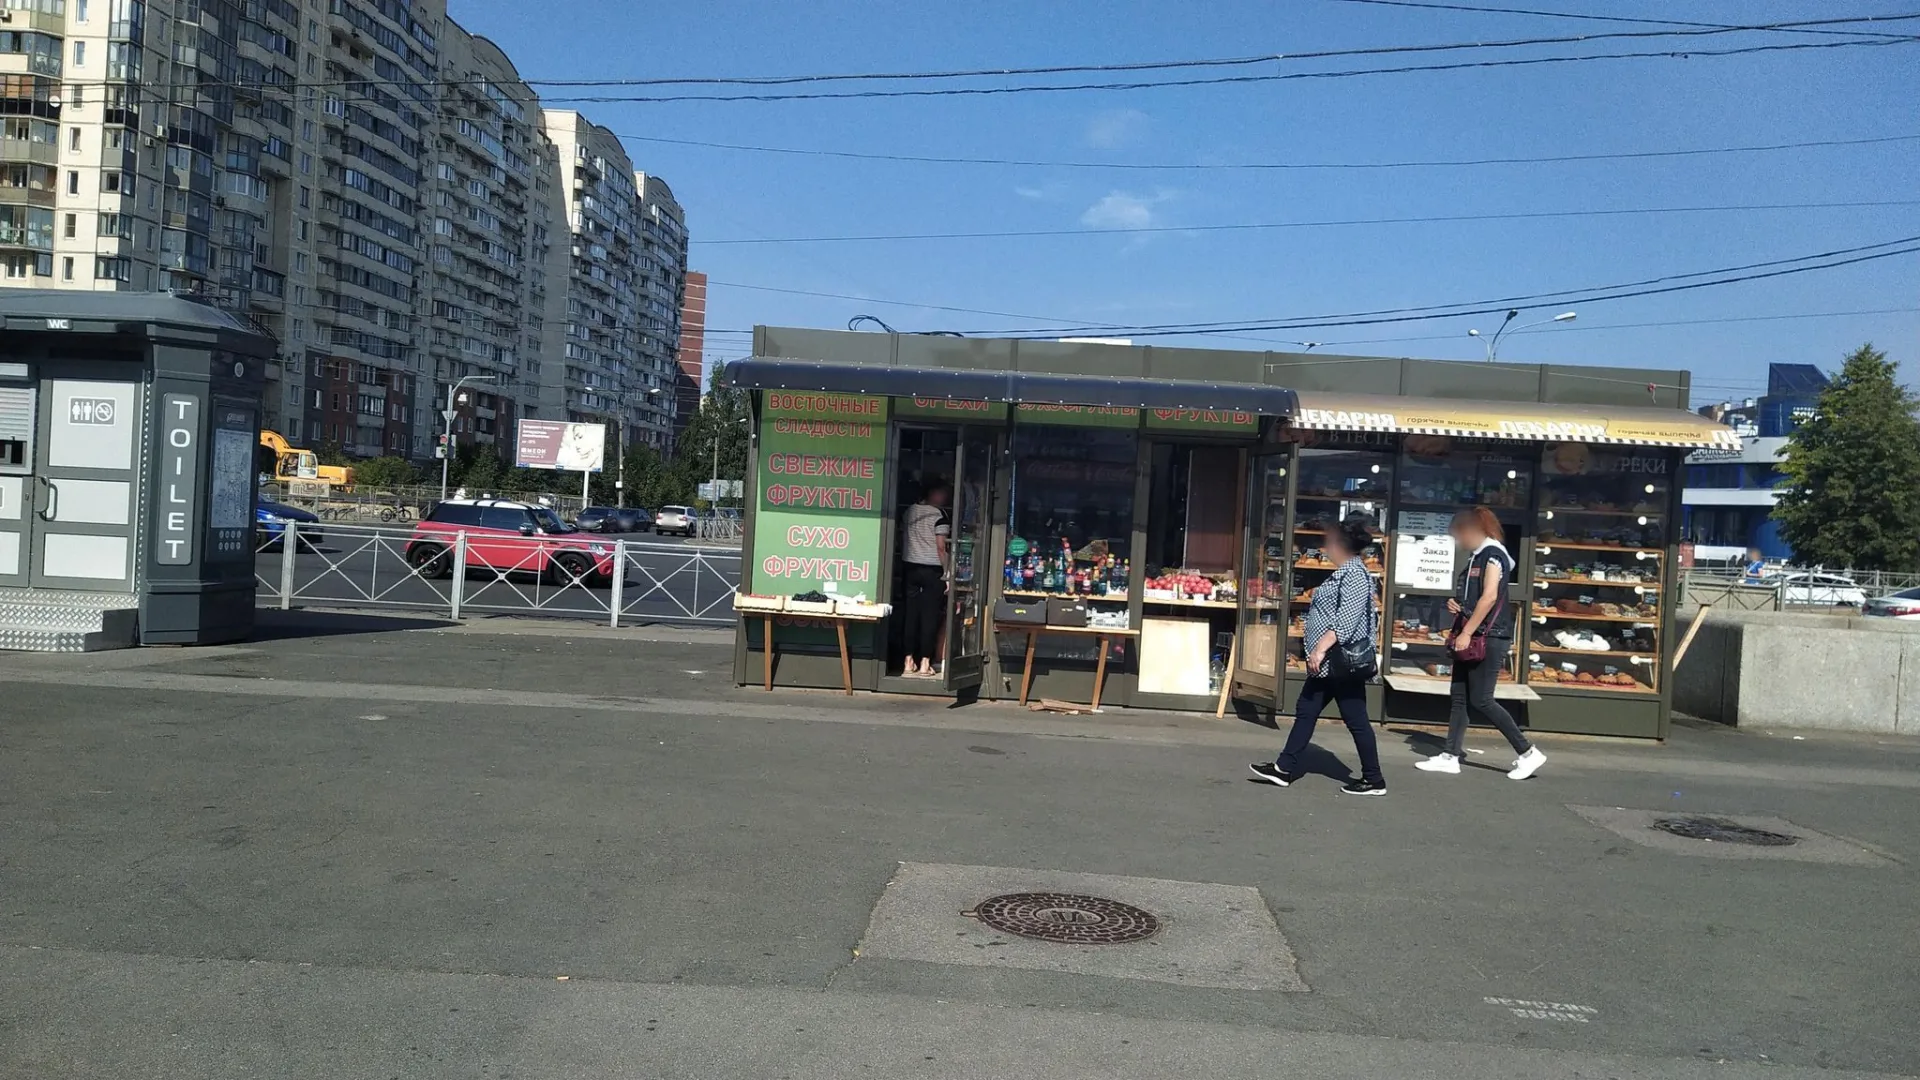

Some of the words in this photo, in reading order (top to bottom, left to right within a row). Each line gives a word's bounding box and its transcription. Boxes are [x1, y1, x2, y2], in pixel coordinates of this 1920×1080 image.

[47, 319, 68, 329] WC
[769, 394, 880, 414] ВОСТОЧНЫЕ
[1154, 408, 1254, 425] ФРУКТЫ
[774, 417, 871, 438] СЛАДОСТИ
[1498, 421, 1604, 437] ПЕКАРНЯ
[768, 453, 875, 478] СВЕЖИЕ
[165, 400, 192, 559] TOILET
[767, 484, 873, 510] ФРУКТЫ
[787, 525, 850, 549] СУХО
[1422, 546, 1449, 556] Заказ
[763, 555, 870, 581] ФРУКТЫ
[1416, 566, 1450, 574] Лепешка
